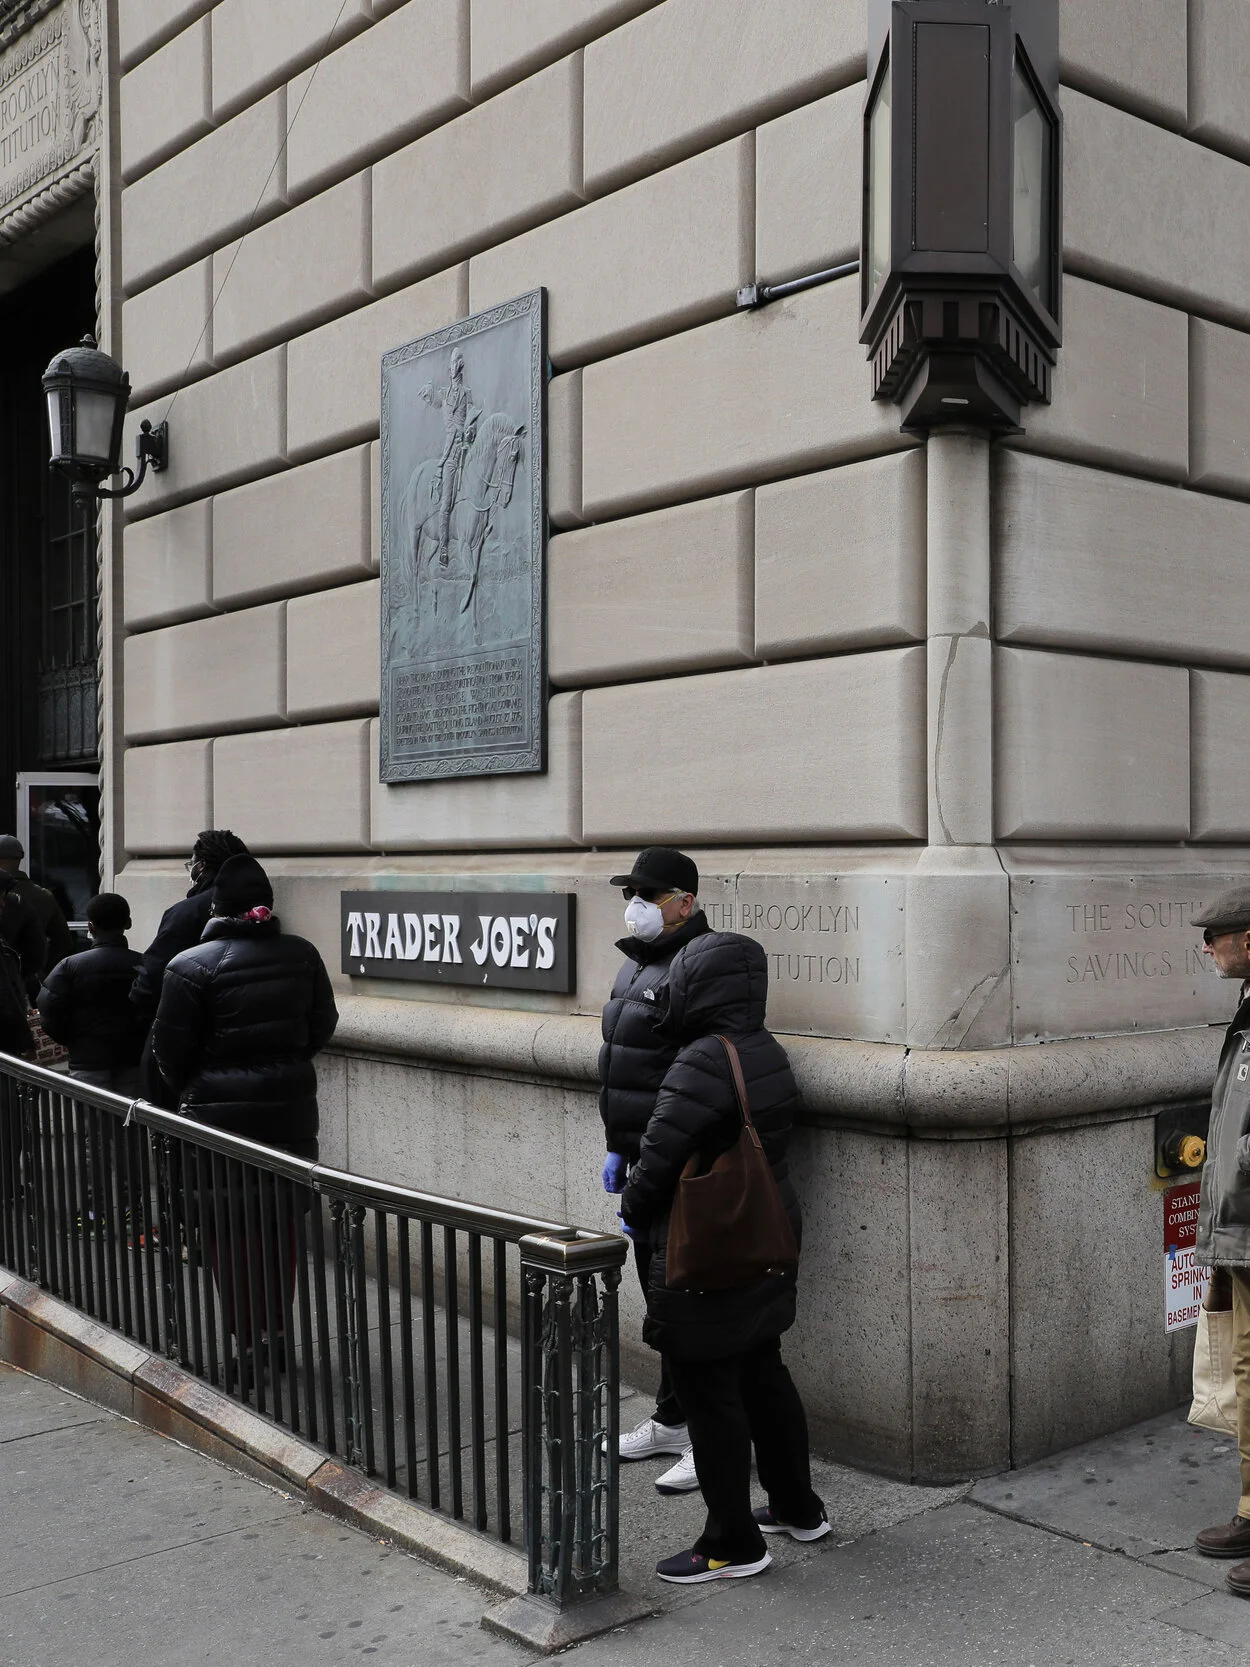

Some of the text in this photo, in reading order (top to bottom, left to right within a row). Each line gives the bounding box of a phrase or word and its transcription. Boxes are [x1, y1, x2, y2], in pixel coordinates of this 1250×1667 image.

[1, 55, 60, 130] ROOKLYN
[1, 95, 60, 168] TITUTION
[742, 903, 859, 934] BROOKLYN
[1066, 903, 1111, 933] THE
[1124, 902, 1205, 929] SOUT
[345, 911, 560, 970] TRADER JOE'S
[766, 953, 860, 985] TUTION
[1067, 951, 1172, 983] SAVINGS
[1168, 1208, 1200, 1226] COMBIN
[1172, 1193, 1201, 1210] STAND
[1172, 1252, 1195, 1273] AUTO
[1172, 1265, 1210, 1290] SPRINKL
[1193, 1284, 1202, 1301] IN
[1168, 1304, 1201, 1326] BASEMEN
